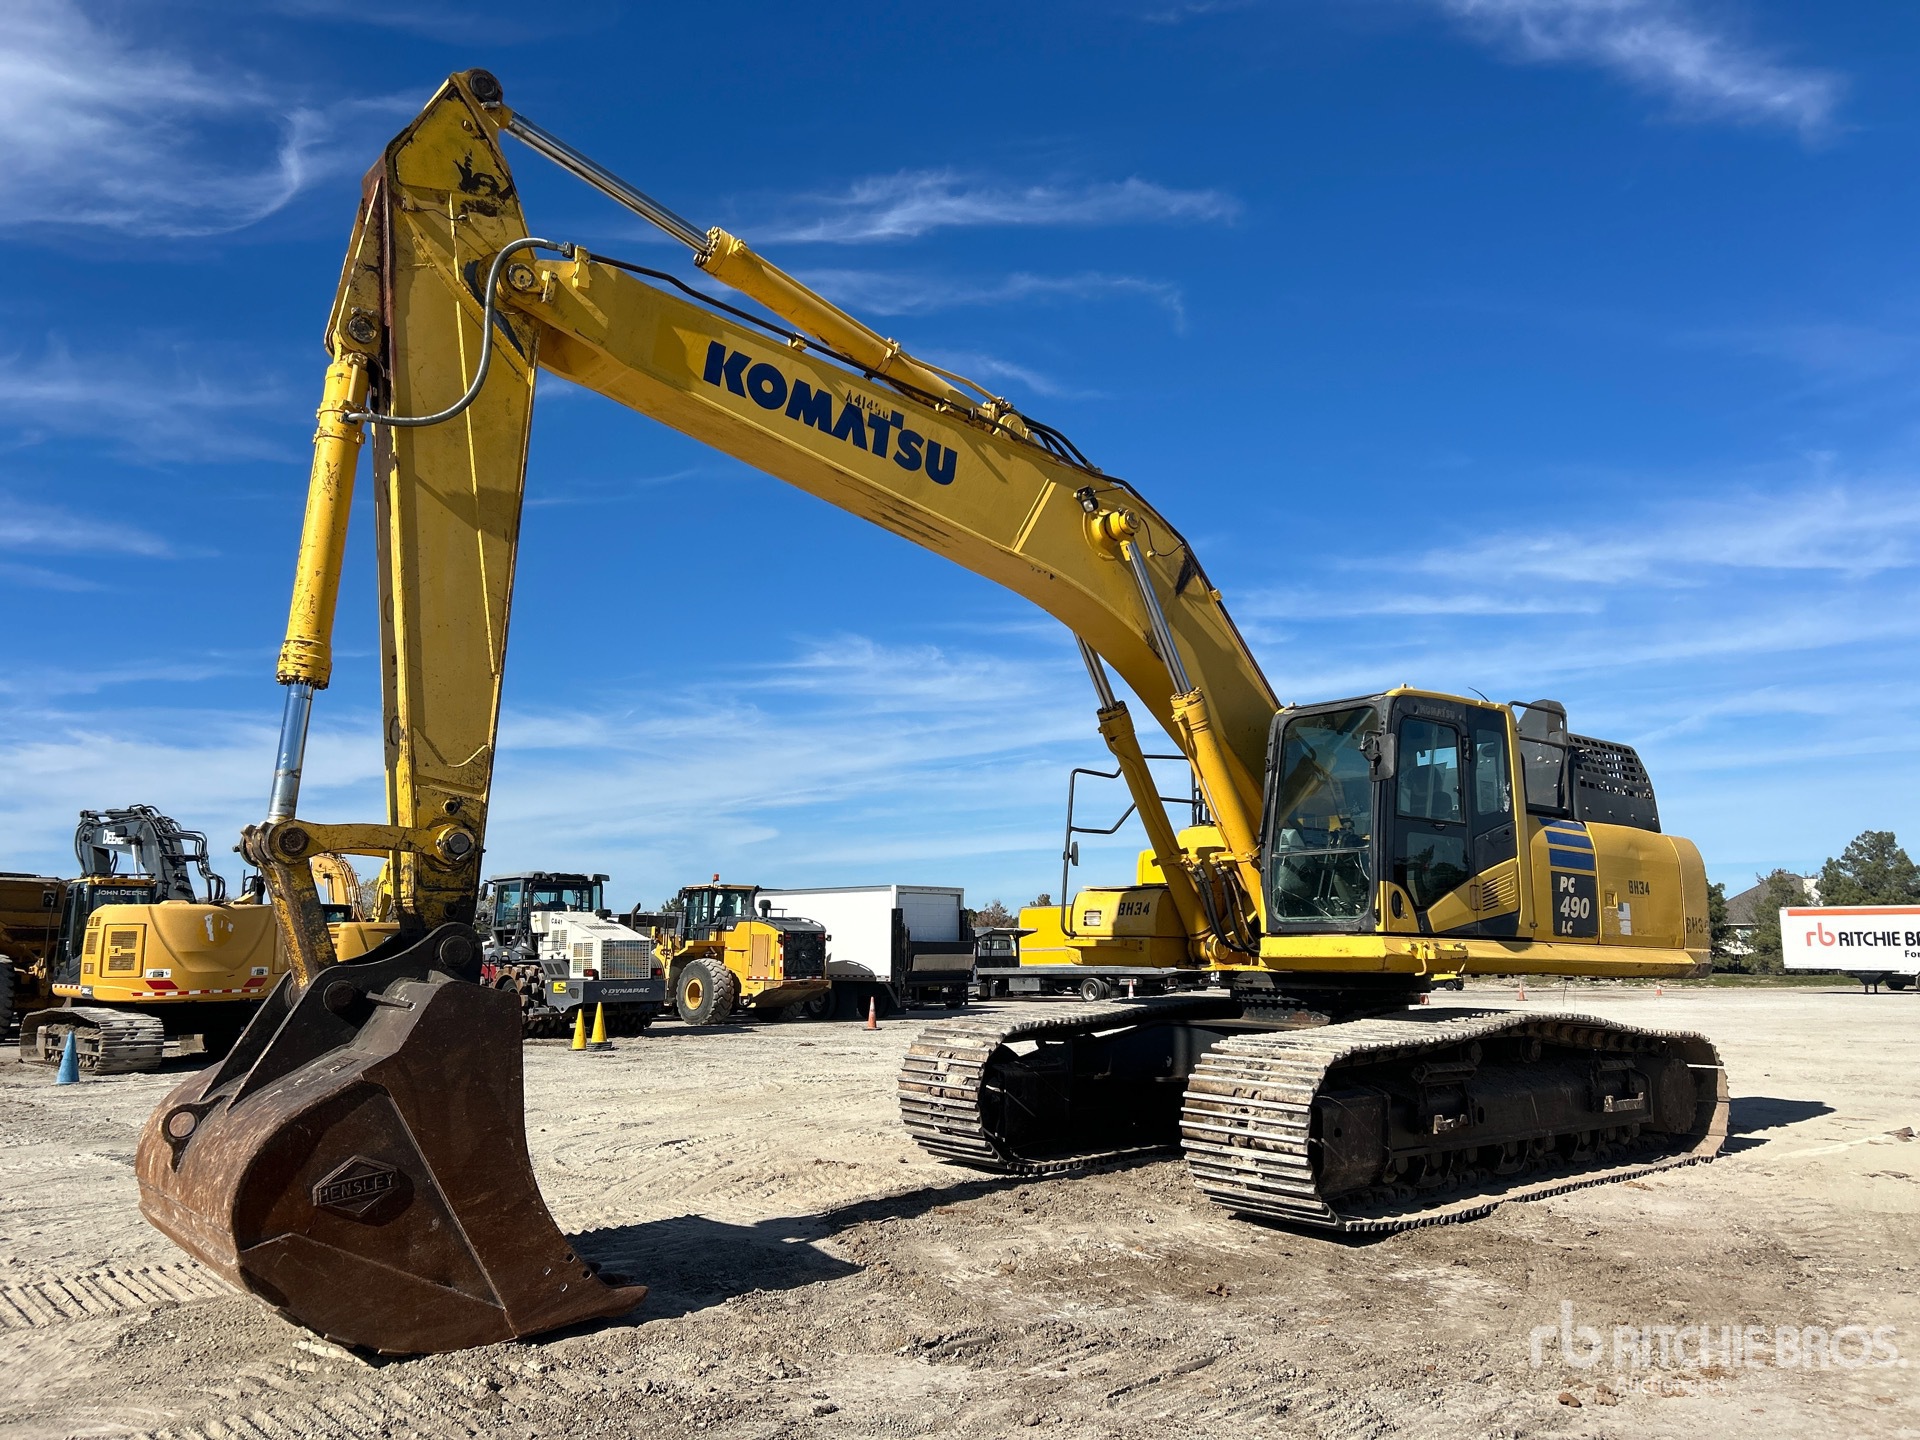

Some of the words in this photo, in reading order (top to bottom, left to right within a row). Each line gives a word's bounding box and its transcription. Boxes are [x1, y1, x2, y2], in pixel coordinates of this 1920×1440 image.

[703, 340, 958, 486] KOMATSU
[1420, 704, 1455, 720] KOMATSU
[1559, 876, 1576, 894] PC
[1628, 879, 1650, 896] BH34
[1118, 901, 1151, 916] BH34
[1559, 895, 1590, 919] 490
[1561, 920, 1573, 934] LC
[1838, 931, 1901, 946] RITCHIE
[318, 1172, 394, 1204] HENSLEY
